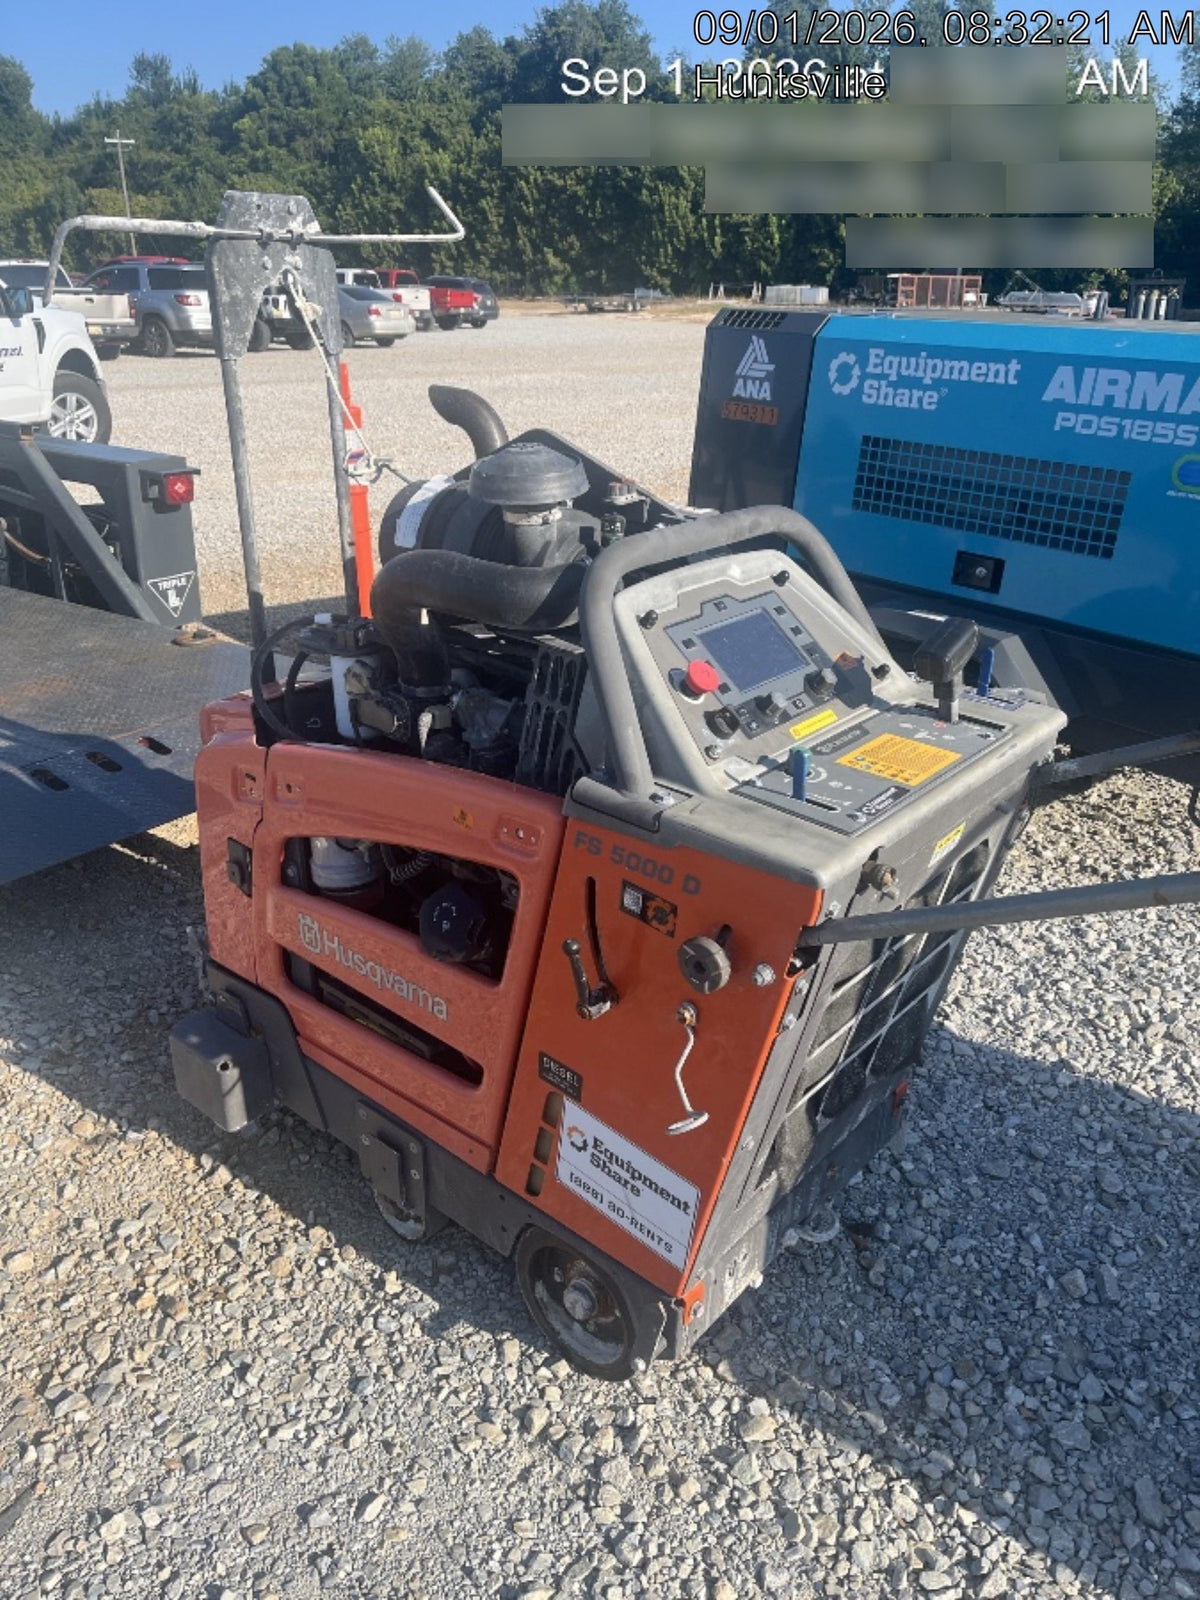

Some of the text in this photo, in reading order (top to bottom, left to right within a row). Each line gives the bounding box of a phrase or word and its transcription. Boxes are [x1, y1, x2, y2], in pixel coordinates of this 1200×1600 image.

[866, 349, 1021, 385] Equipment
[732, 378, 771, 400] ANA
[1054, 411, 1200, 447] PDS185S
[158, 577, 186, 590] TRIPLE
[574, 831, 702, 896] FS 5000 D
[323, 929, 448, 1022] Husqvarna
[589, 1151, 641, 1197] Share
[591, 1136, 691, 1216] Equipment
